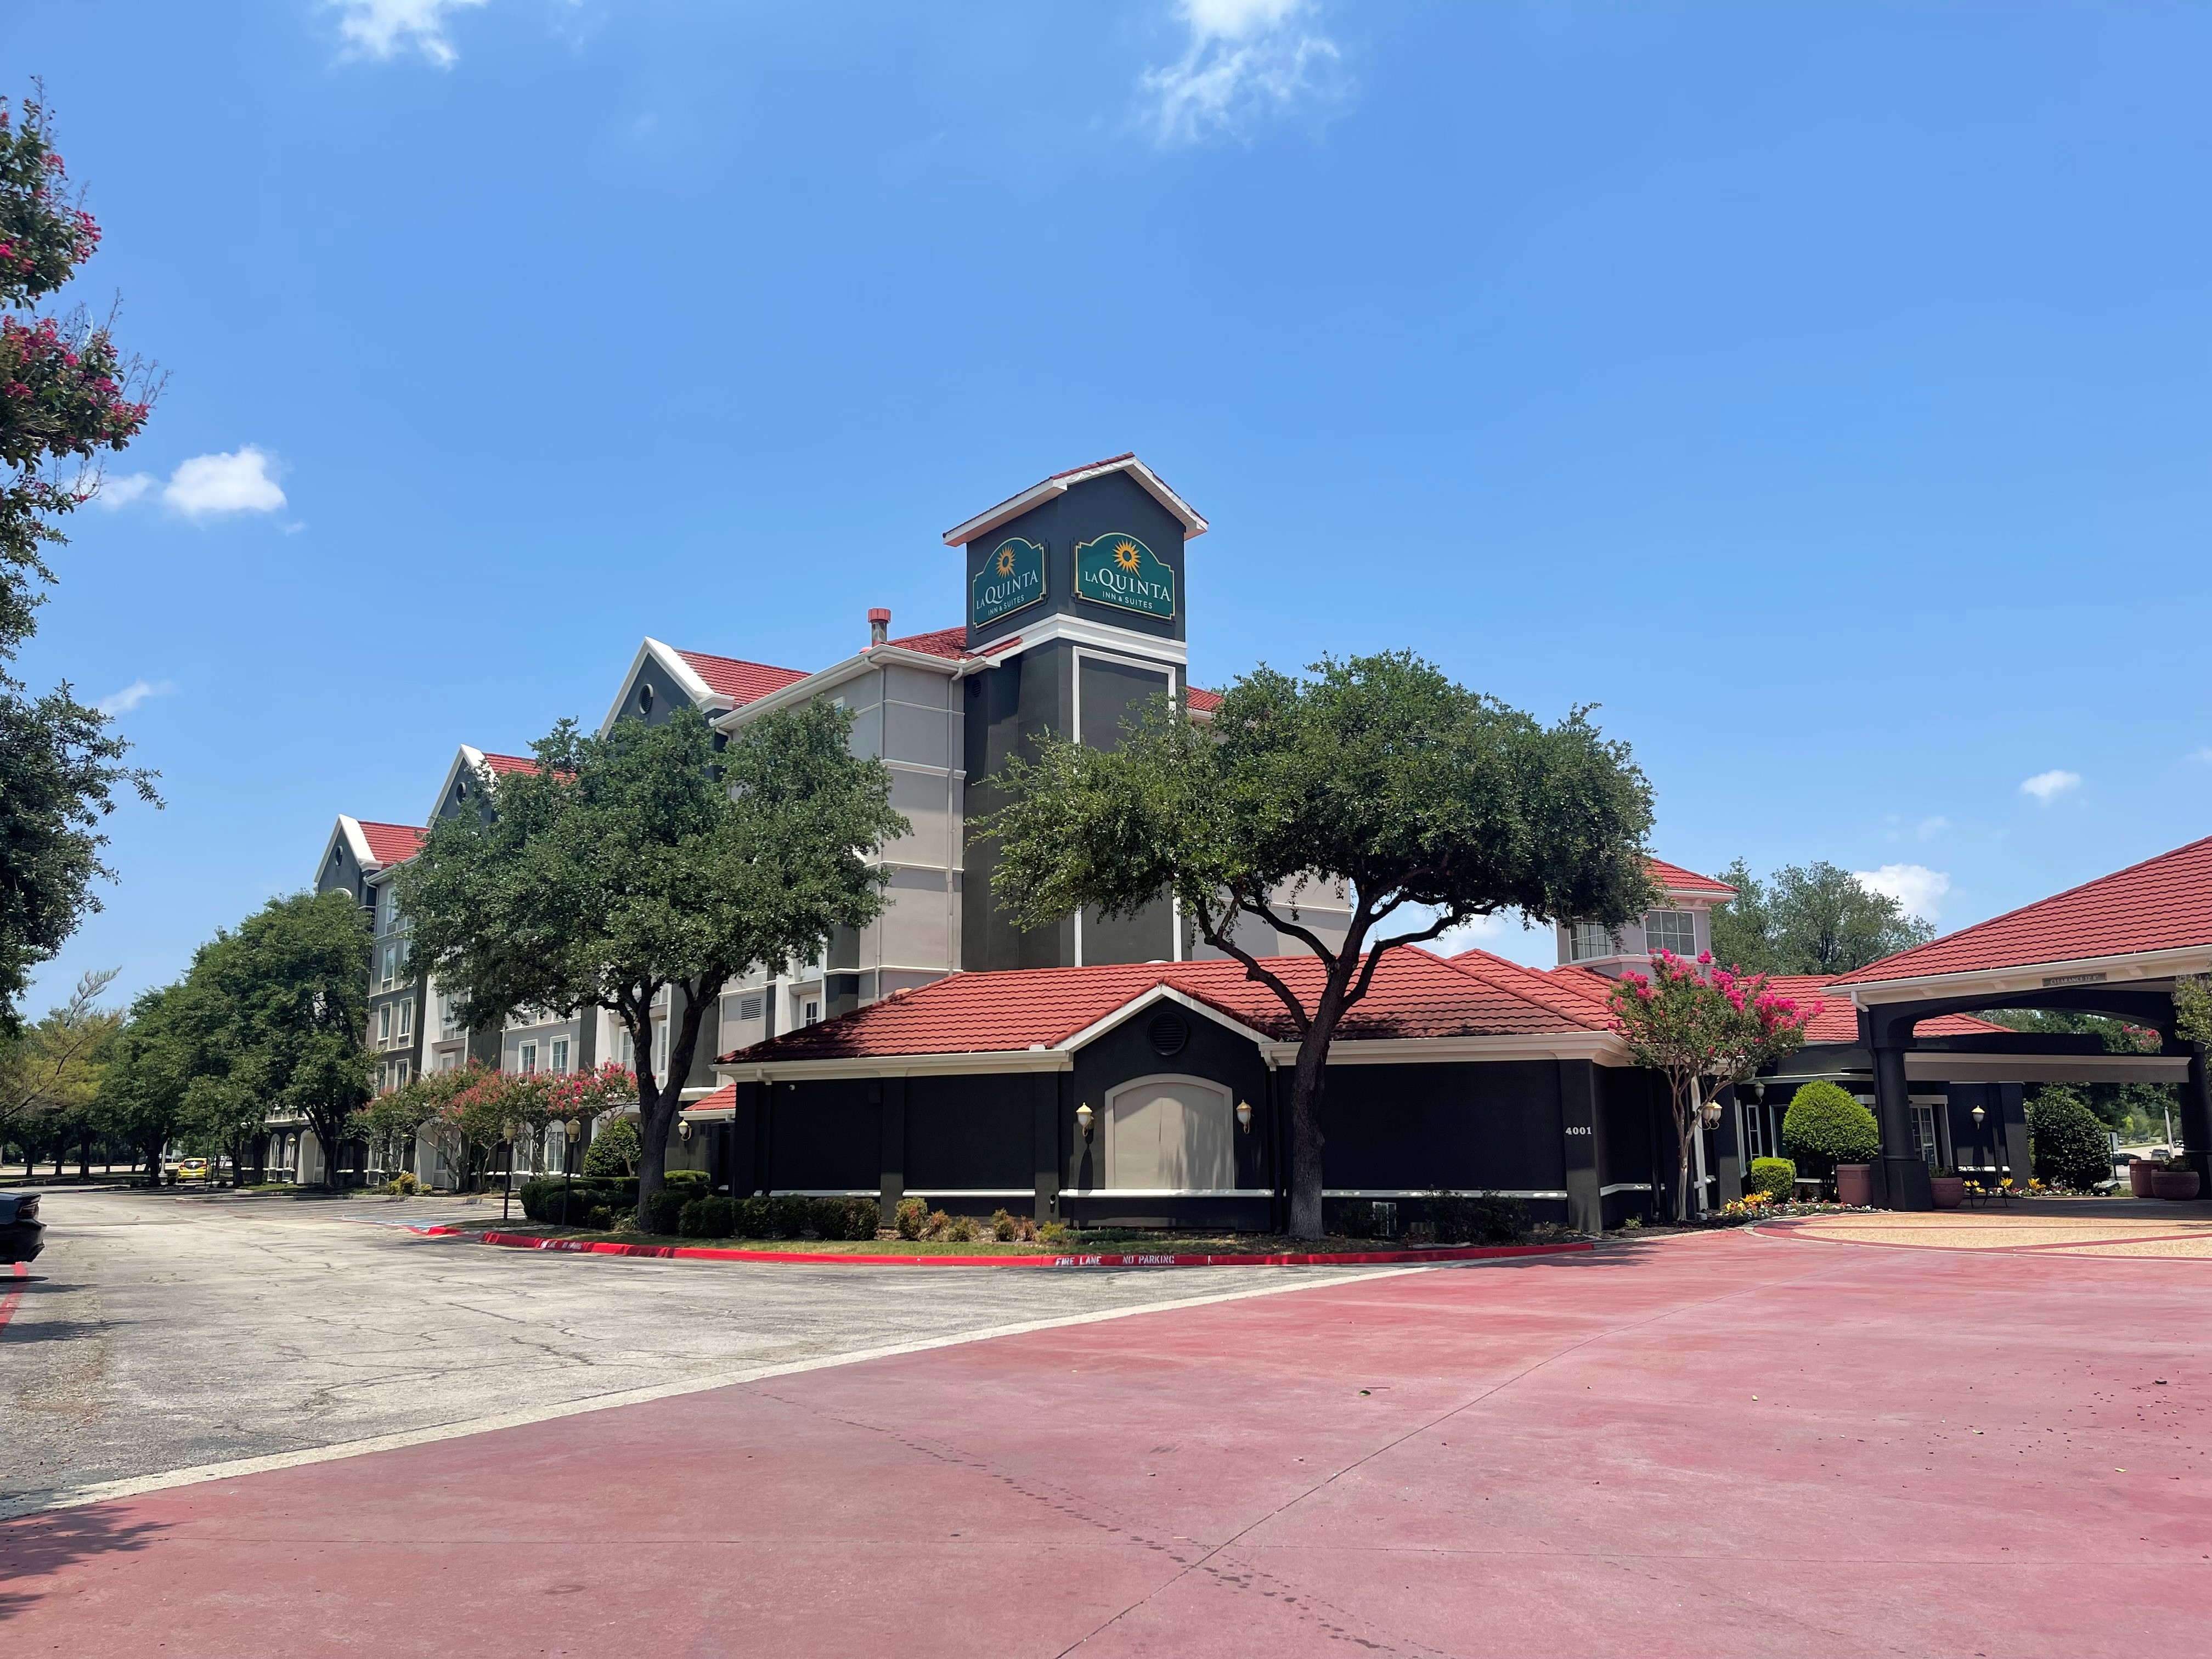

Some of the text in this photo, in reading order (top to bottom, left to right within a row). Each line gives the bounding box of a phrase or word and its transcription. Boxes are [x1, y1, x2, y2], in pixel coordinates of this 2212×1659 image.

[977, 569, 1039, 610] LA QUINTA
[1085, 568, 1171, 602] LA QUINTA
[988, 606, 998, 616] INN
[1003, 594, 1025, 610] SUITES
[1102, 590, 1116, 601] INN
[1125, 596, 1153, 610] SUITES
[2050, 976, 2084, 985] CLEARANCE
[1565, 1126, 1592, 1135] 4001
[1056, 1255, 1175, 1266] FIRE LANE NO PARKING
